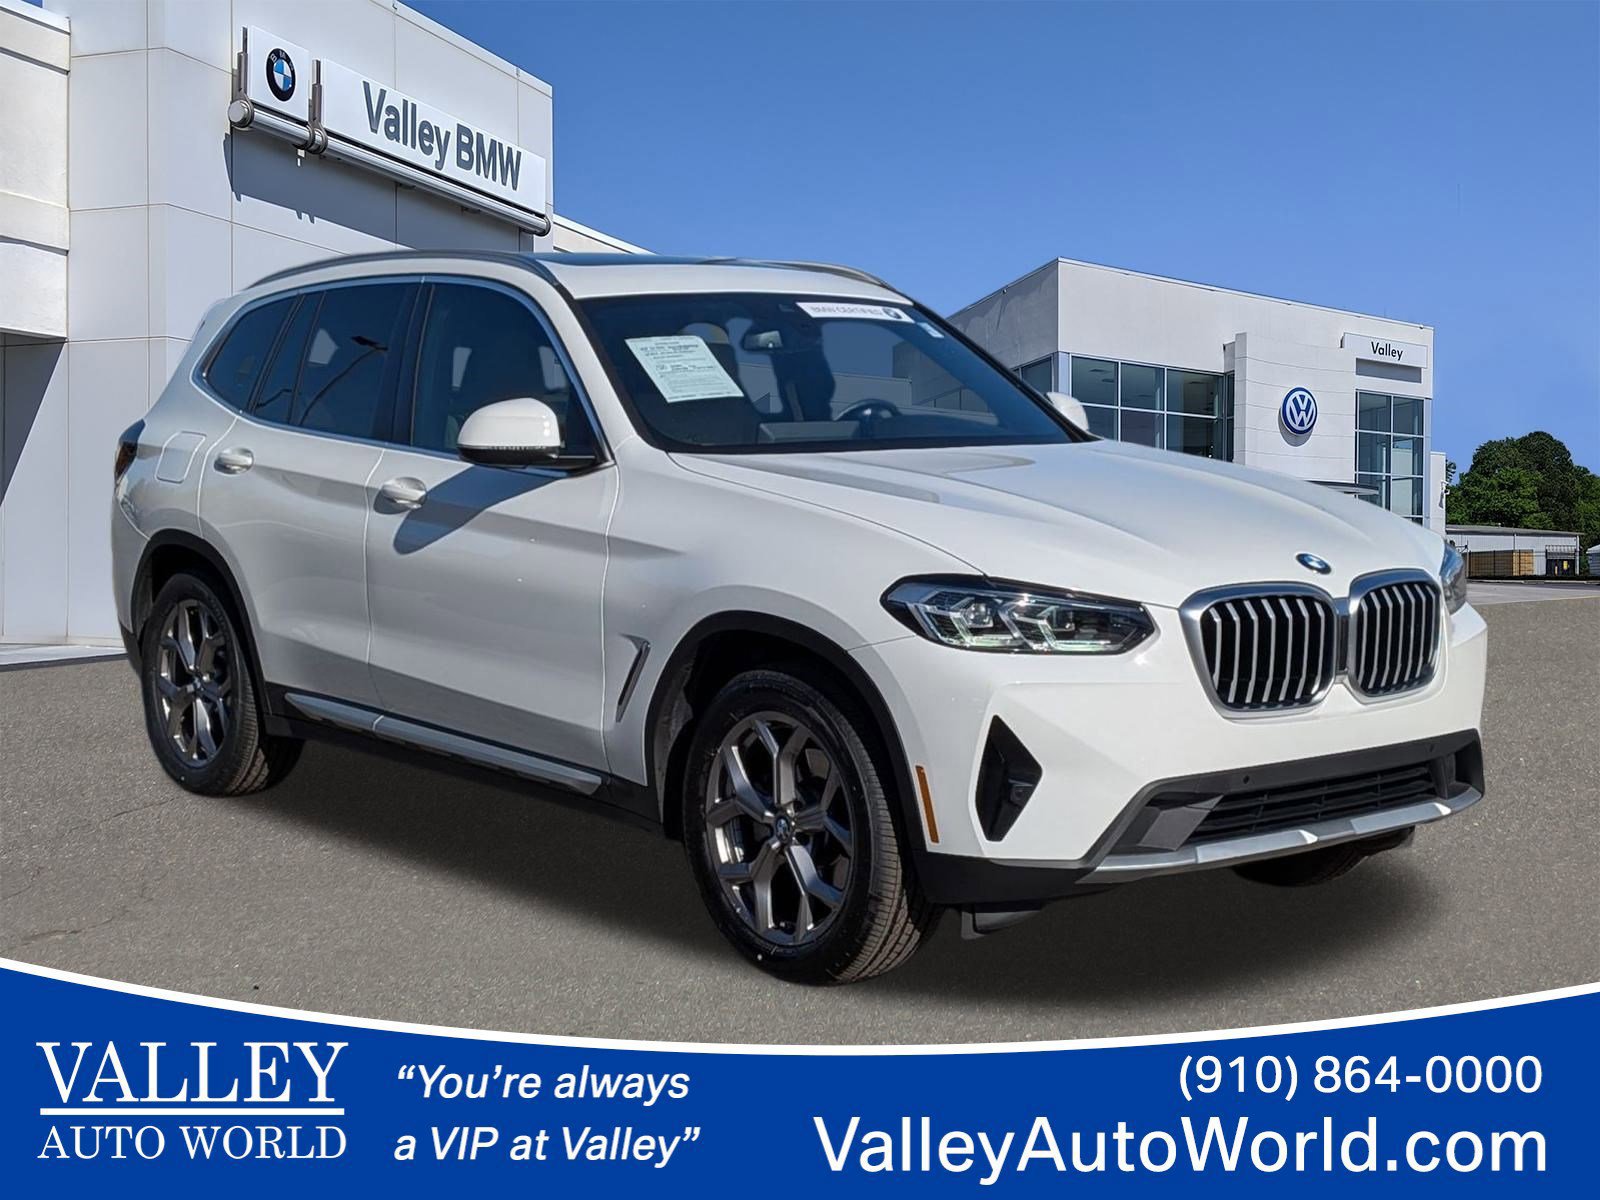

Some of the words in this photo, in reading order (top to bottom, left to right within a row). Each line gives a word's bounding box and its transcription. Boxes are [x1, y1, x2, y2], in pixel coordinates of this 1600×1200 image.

[362, 80, 451, 171] Valley
[456, 123, 522, 191] BMW
[1371, 341, 1403, 361] Valley
